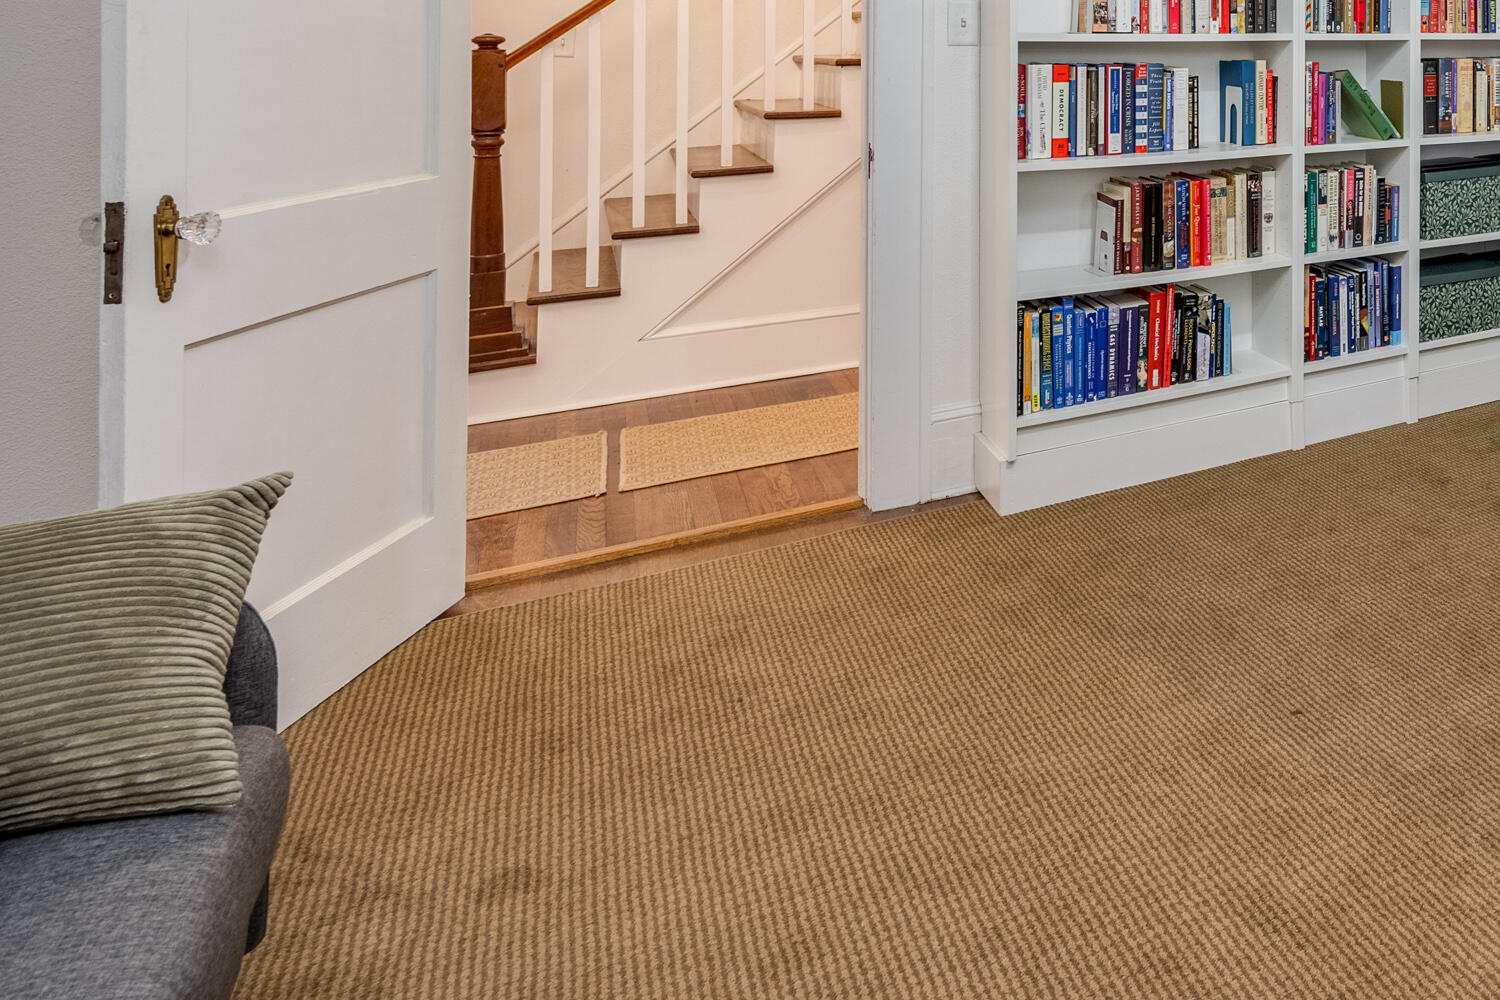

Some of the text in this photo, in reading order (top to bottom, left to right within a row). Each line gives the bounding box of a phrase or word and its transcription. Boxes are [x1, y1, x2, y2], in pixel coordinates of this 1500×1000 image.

[1125, 98, 1132, 106] IN
[1042, 312, 1051, 372] UNDERSTANDING SPACE
